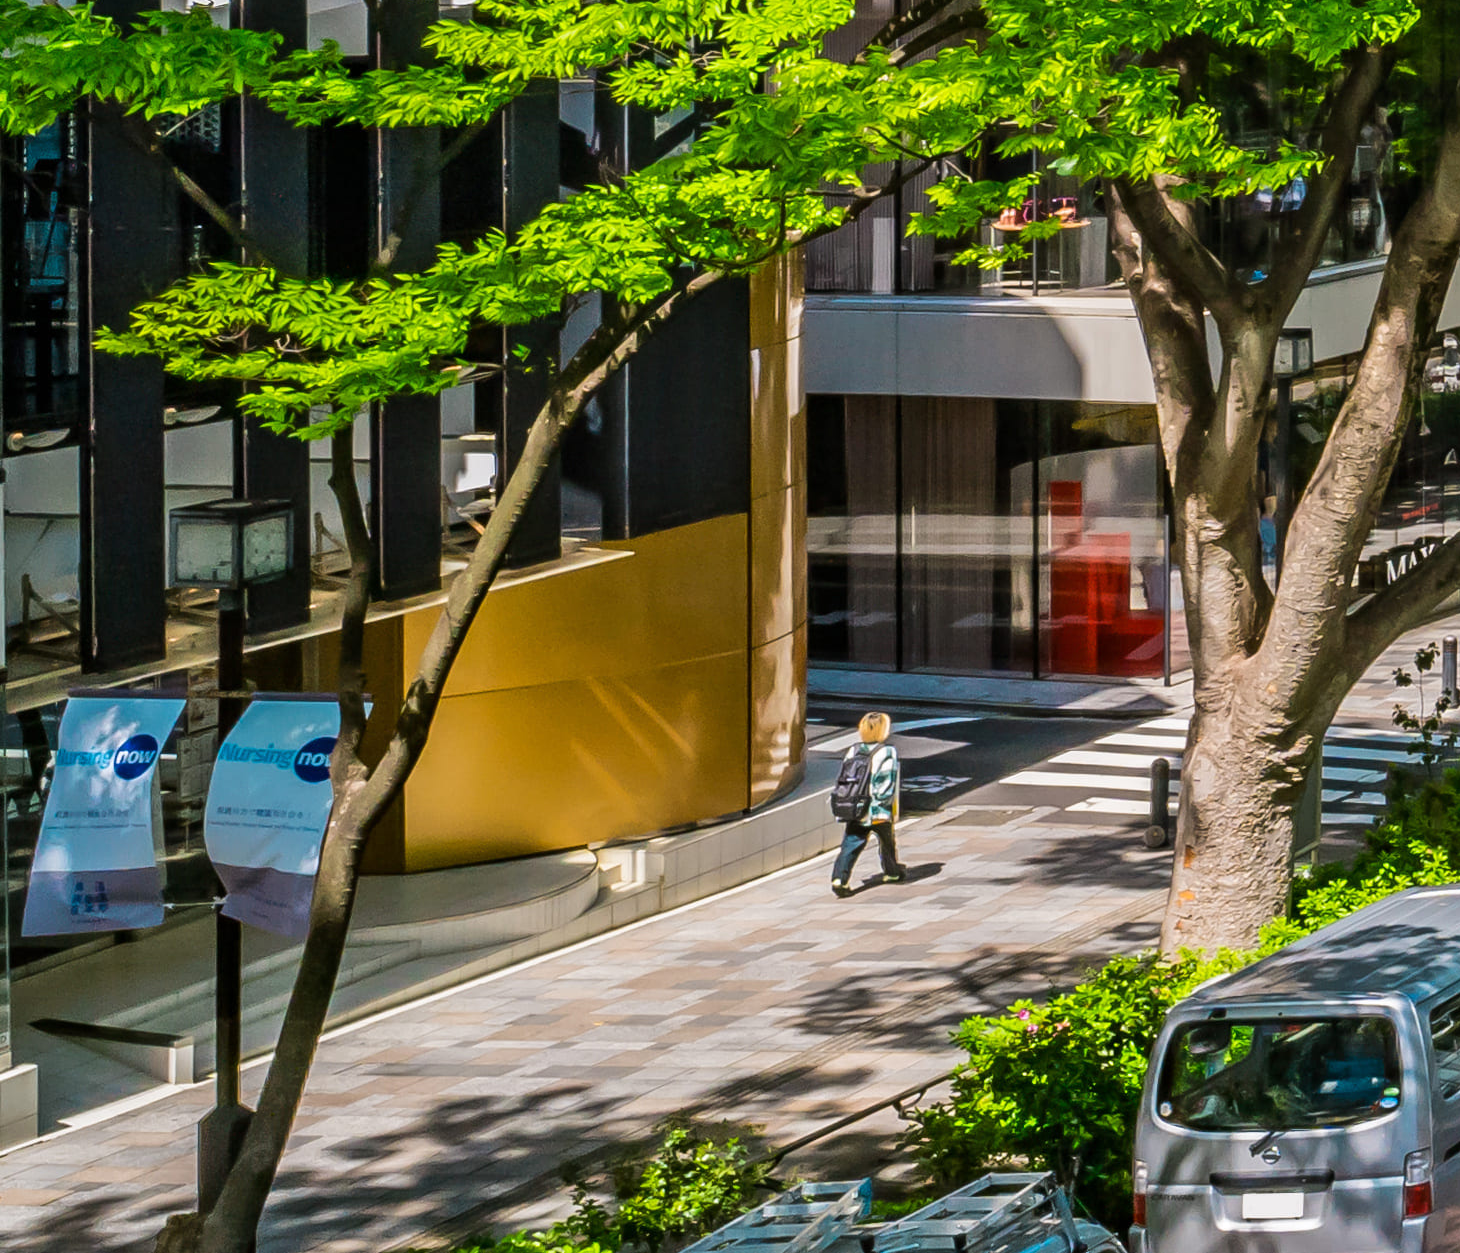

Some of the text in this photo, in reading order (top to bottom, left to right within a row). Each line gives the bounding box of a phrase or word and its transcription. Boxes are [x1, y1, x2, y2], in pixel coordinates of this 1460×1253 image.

[56, 746, 155, 769] Nursing now
[217, 742, 298, 771] Nursing
